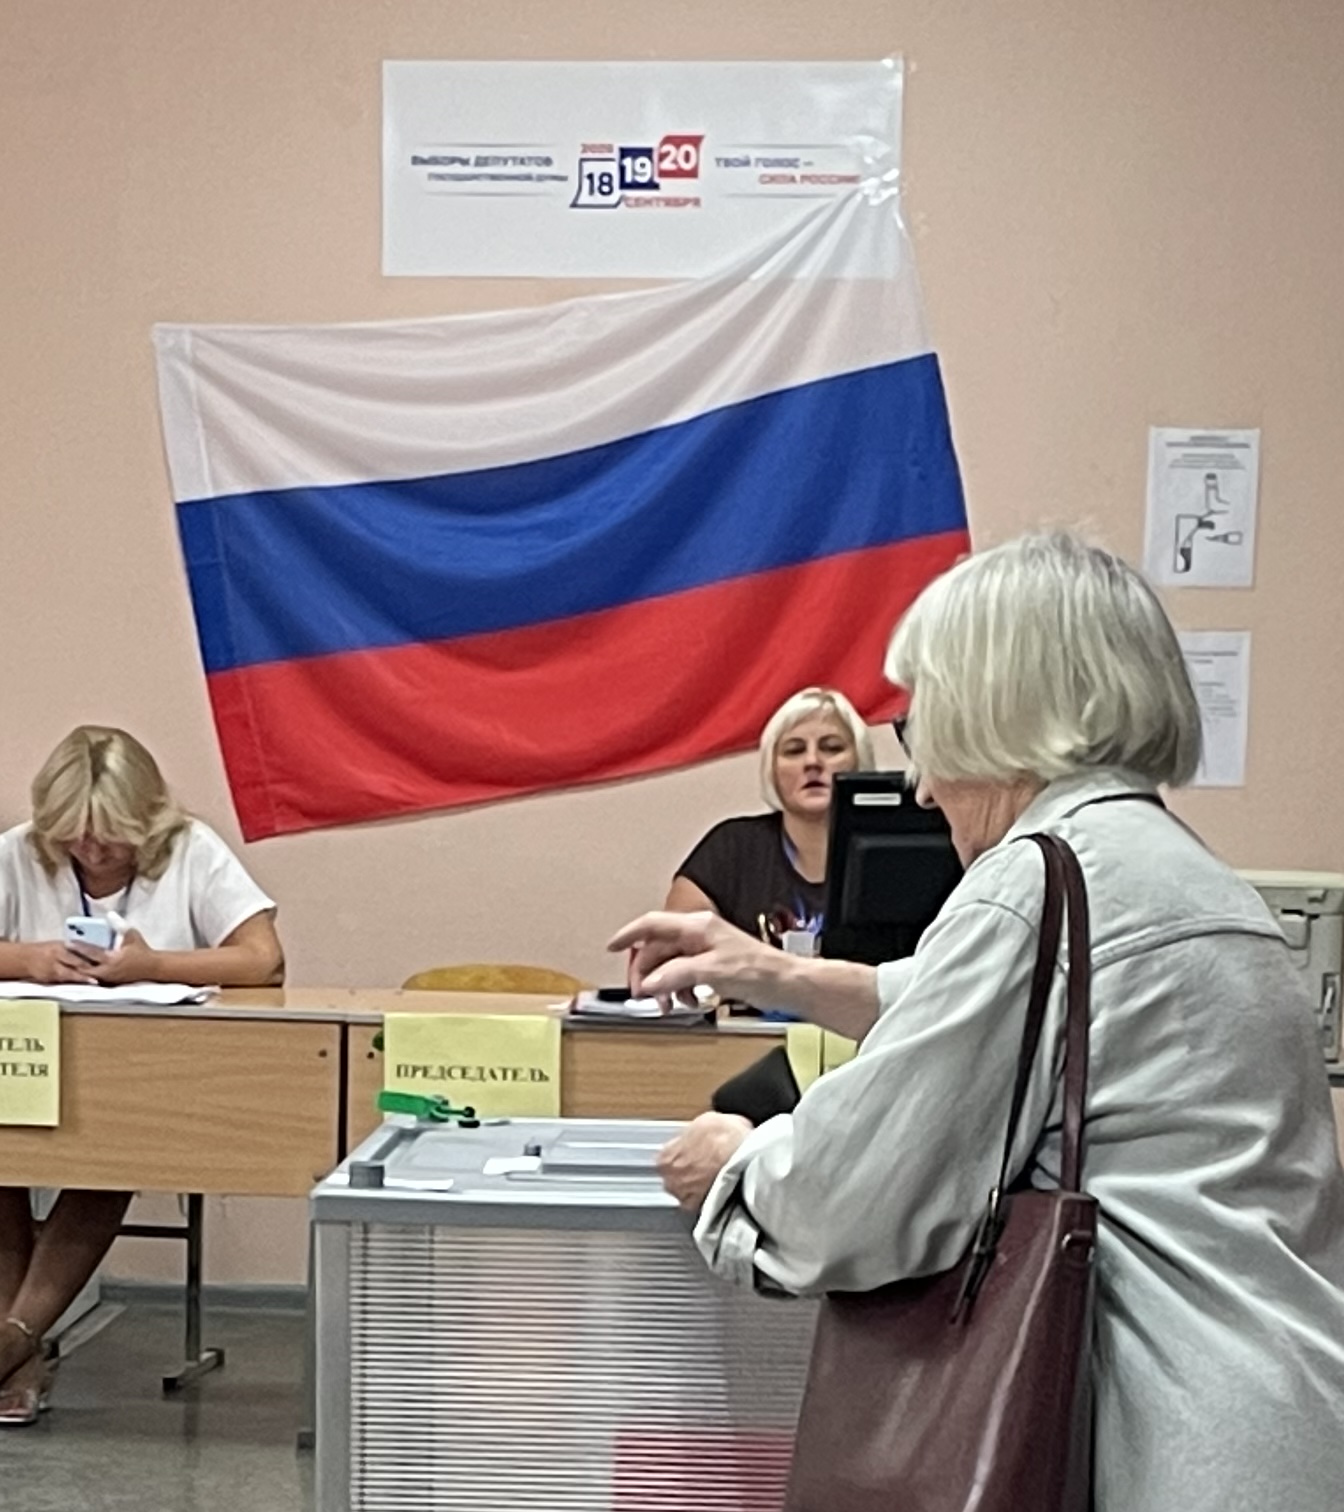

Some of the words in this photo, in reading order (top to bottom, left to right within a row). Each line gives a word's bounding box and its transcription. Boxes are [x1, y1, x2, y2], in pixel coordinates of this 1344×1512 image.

[411, 155, 470, 166] ВЫБОРЫ
[474, 155, 553, 167] ДЕПУТАТОВ
[715, 155, 751, 168] ТВОЙ
[755, 157, 800, 168] ГОЛОС
[586, 172, 613, 195] 18
[621, 156, 652, 183] 19
[659, 144, 697, 171] 20
[624, 197, 701, 208] СЕНТЯБРЯ
[396, 1063, 550, 1082] ПРЕДСЕДАТЕЛЬ
